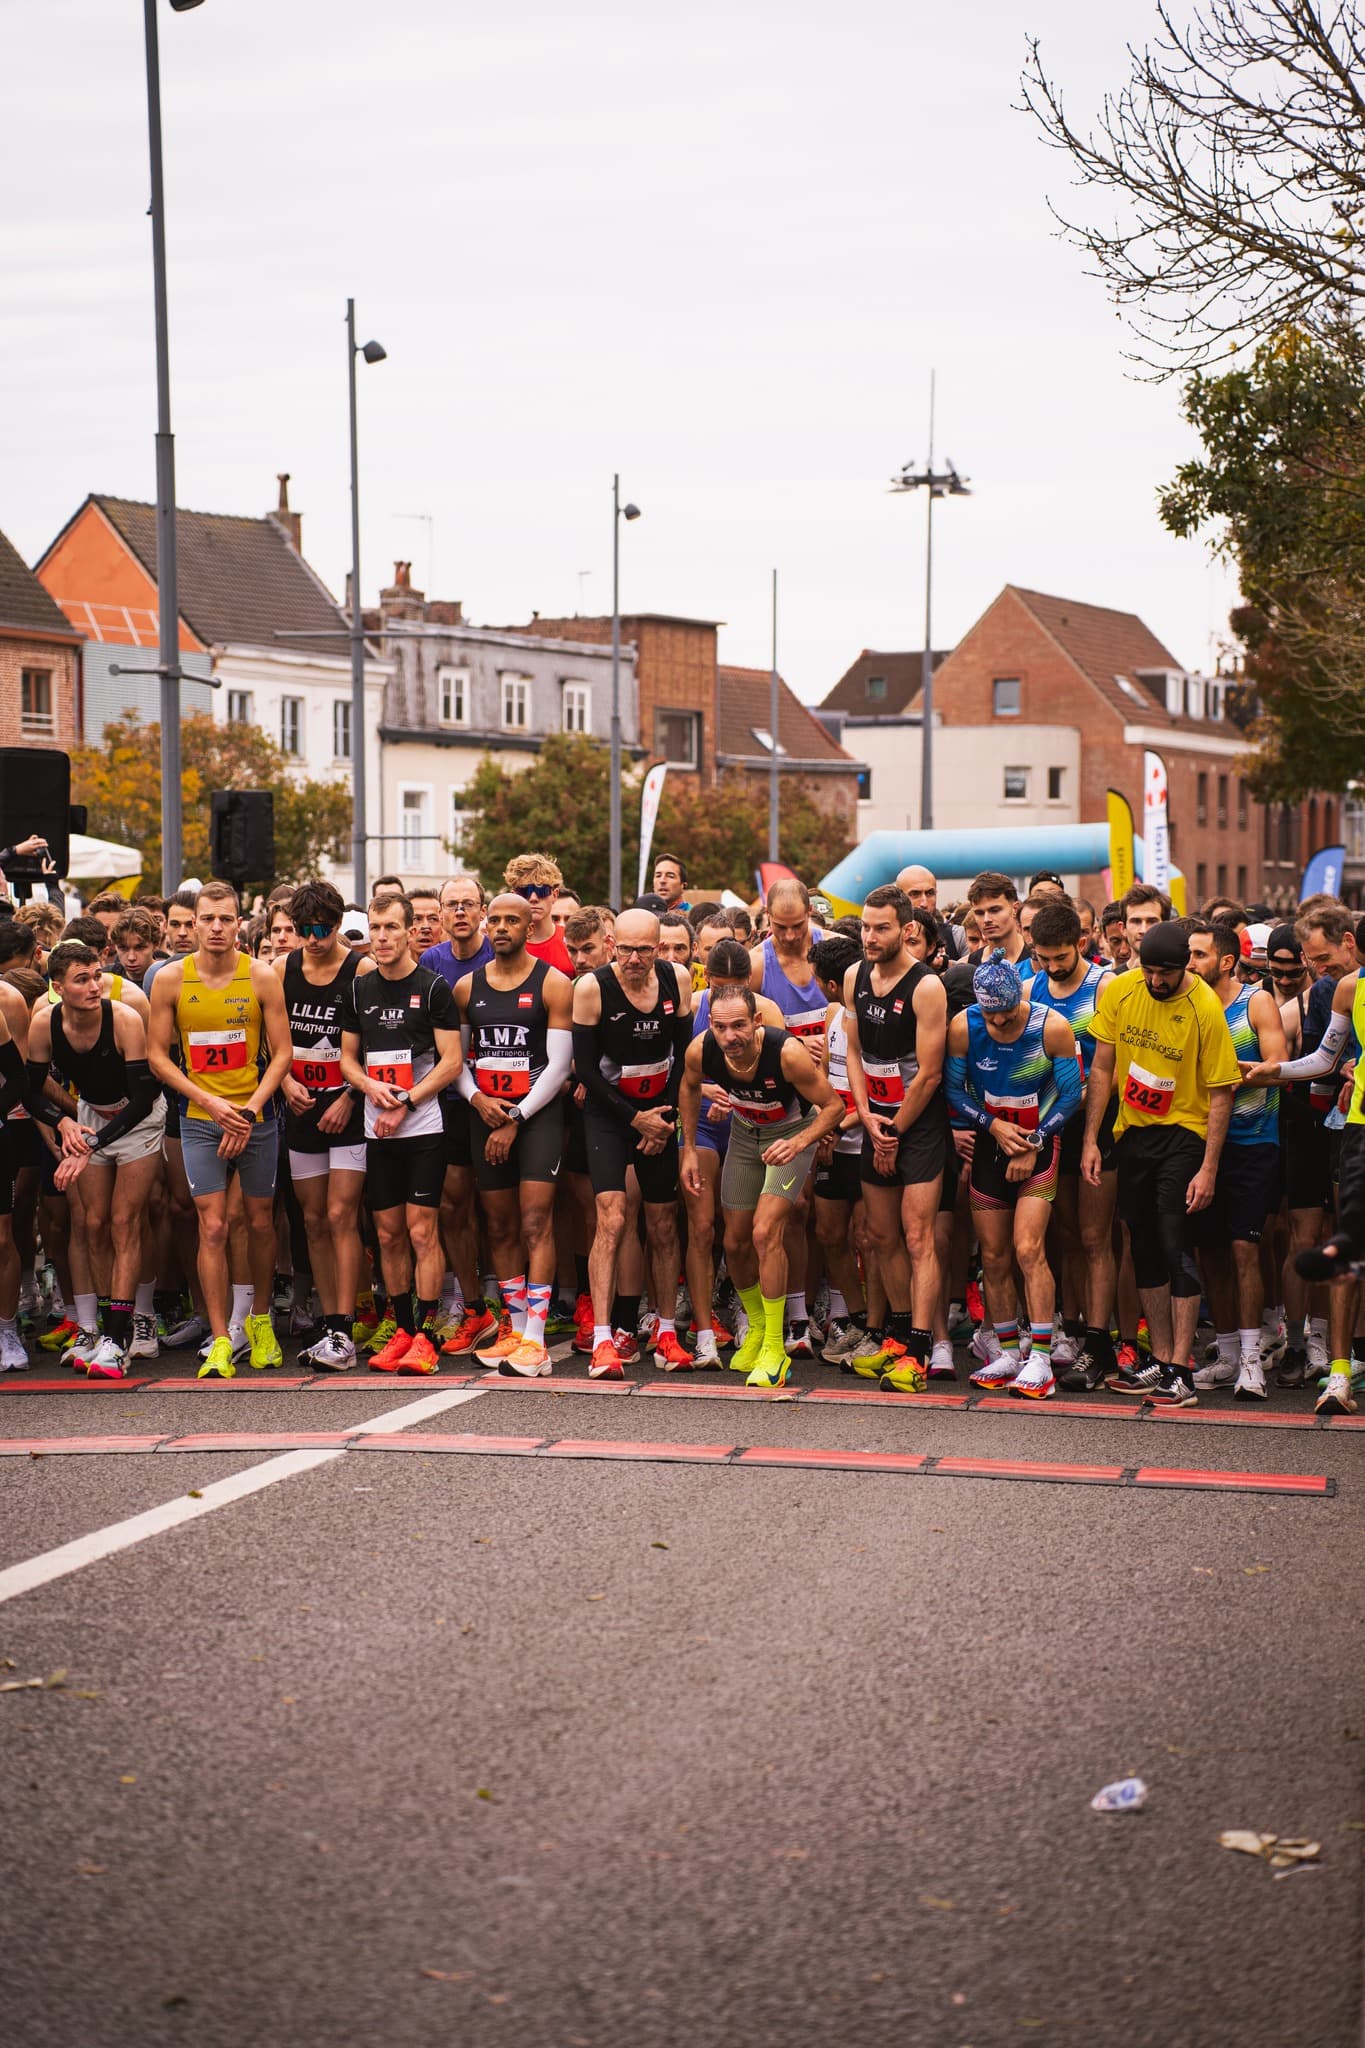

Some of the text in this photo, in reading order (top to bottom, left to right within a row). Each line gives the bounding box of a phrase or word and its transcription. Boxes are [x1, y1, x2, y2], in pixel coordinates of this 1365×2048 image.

[292, 1002, 336, 1020] LILLE
[229, 1032, 241, 1040] UST
[290, 1021, 340, 1035] TRIATHLON
[479, 1026, 530, 1048] LMA
[206, 1047, 229, 1066] 21
[304, 1063, 327, 1083] 60
[375, 1067, 397, 1085] 13
[490, 1073, 513, 1092] 12
[638, 1078, 651, 1094] 8
[1022, 1097, 1034, 1105] UST
[1127, 1082, 1163, 1110] 242
